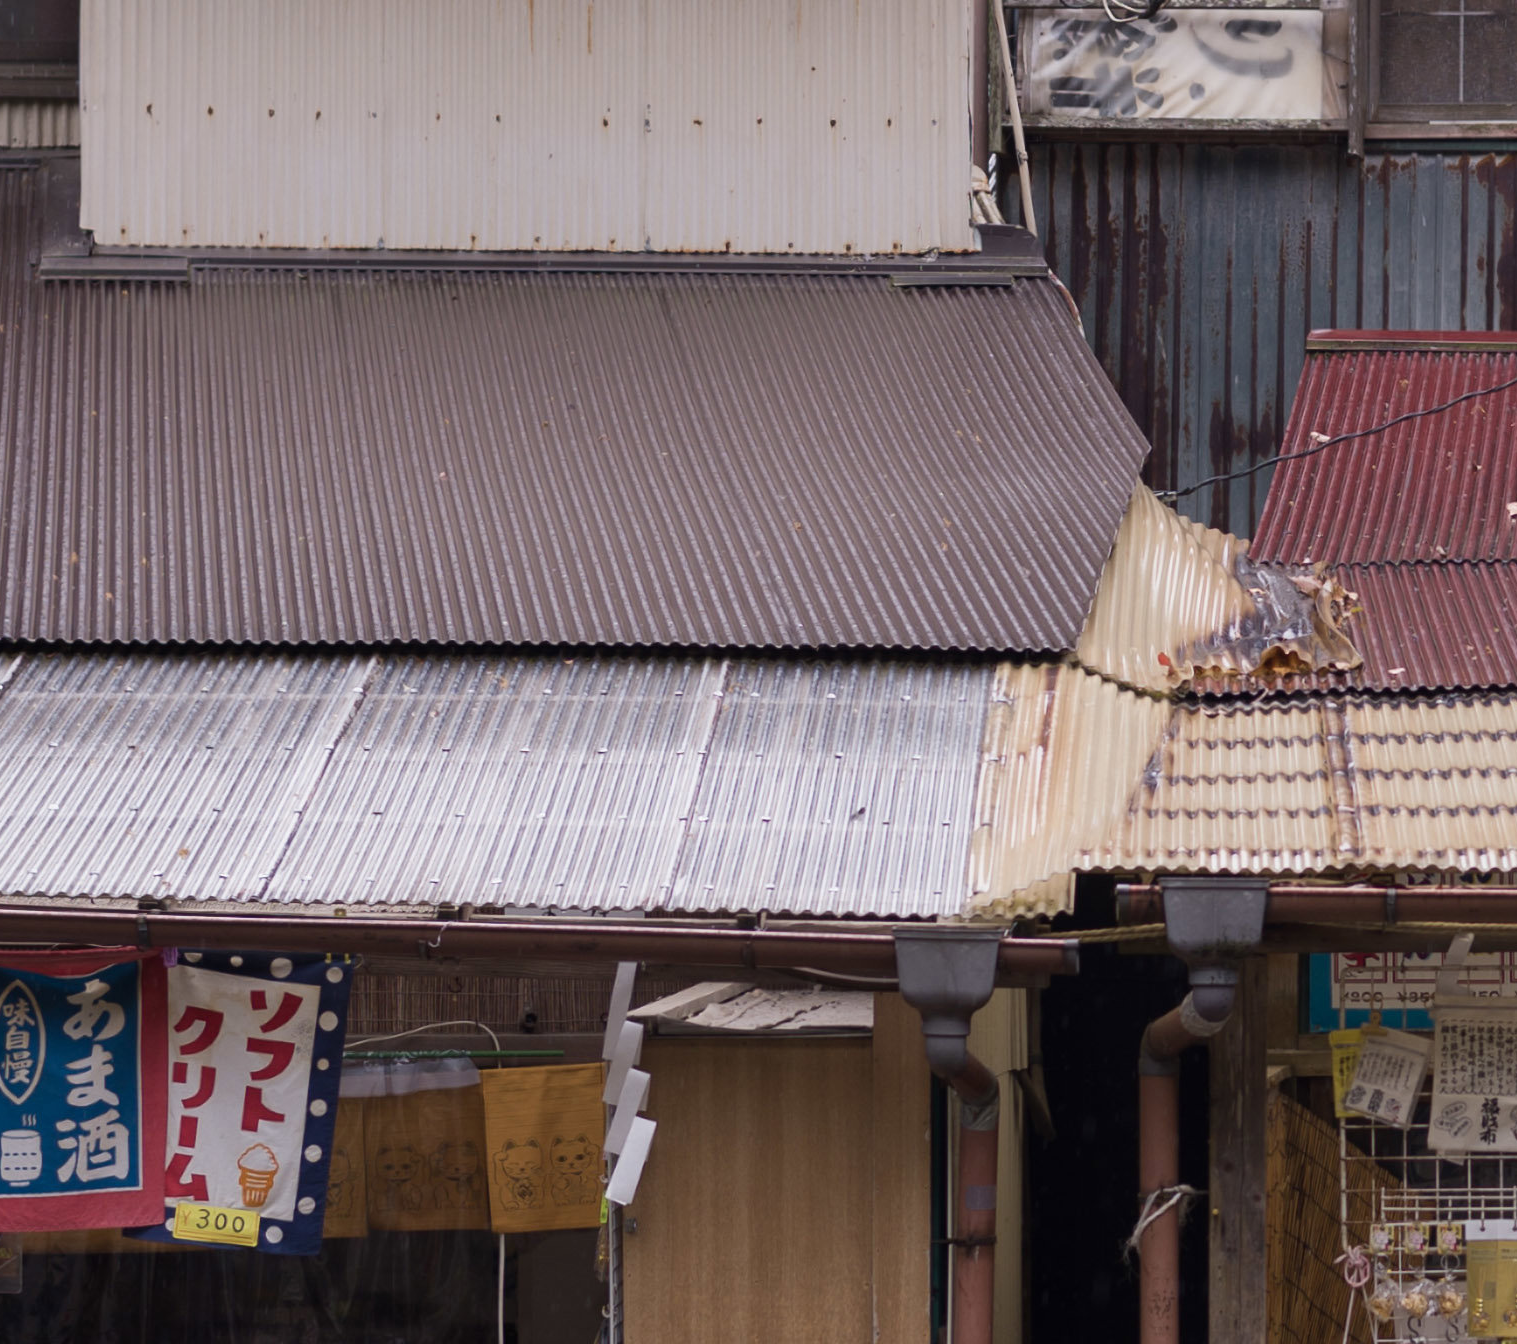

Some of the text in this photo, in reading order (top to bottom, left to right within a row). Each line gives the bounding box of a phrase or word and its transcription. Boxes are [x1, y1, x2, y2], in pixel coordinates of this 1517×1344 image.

[1, 1001, 36, 1085] 味自慢
[55, 978, 131, 1184] あま酒
[165, 1005, 225, 1202] クリーム
[240, 989, 304, 1133] ソフト
